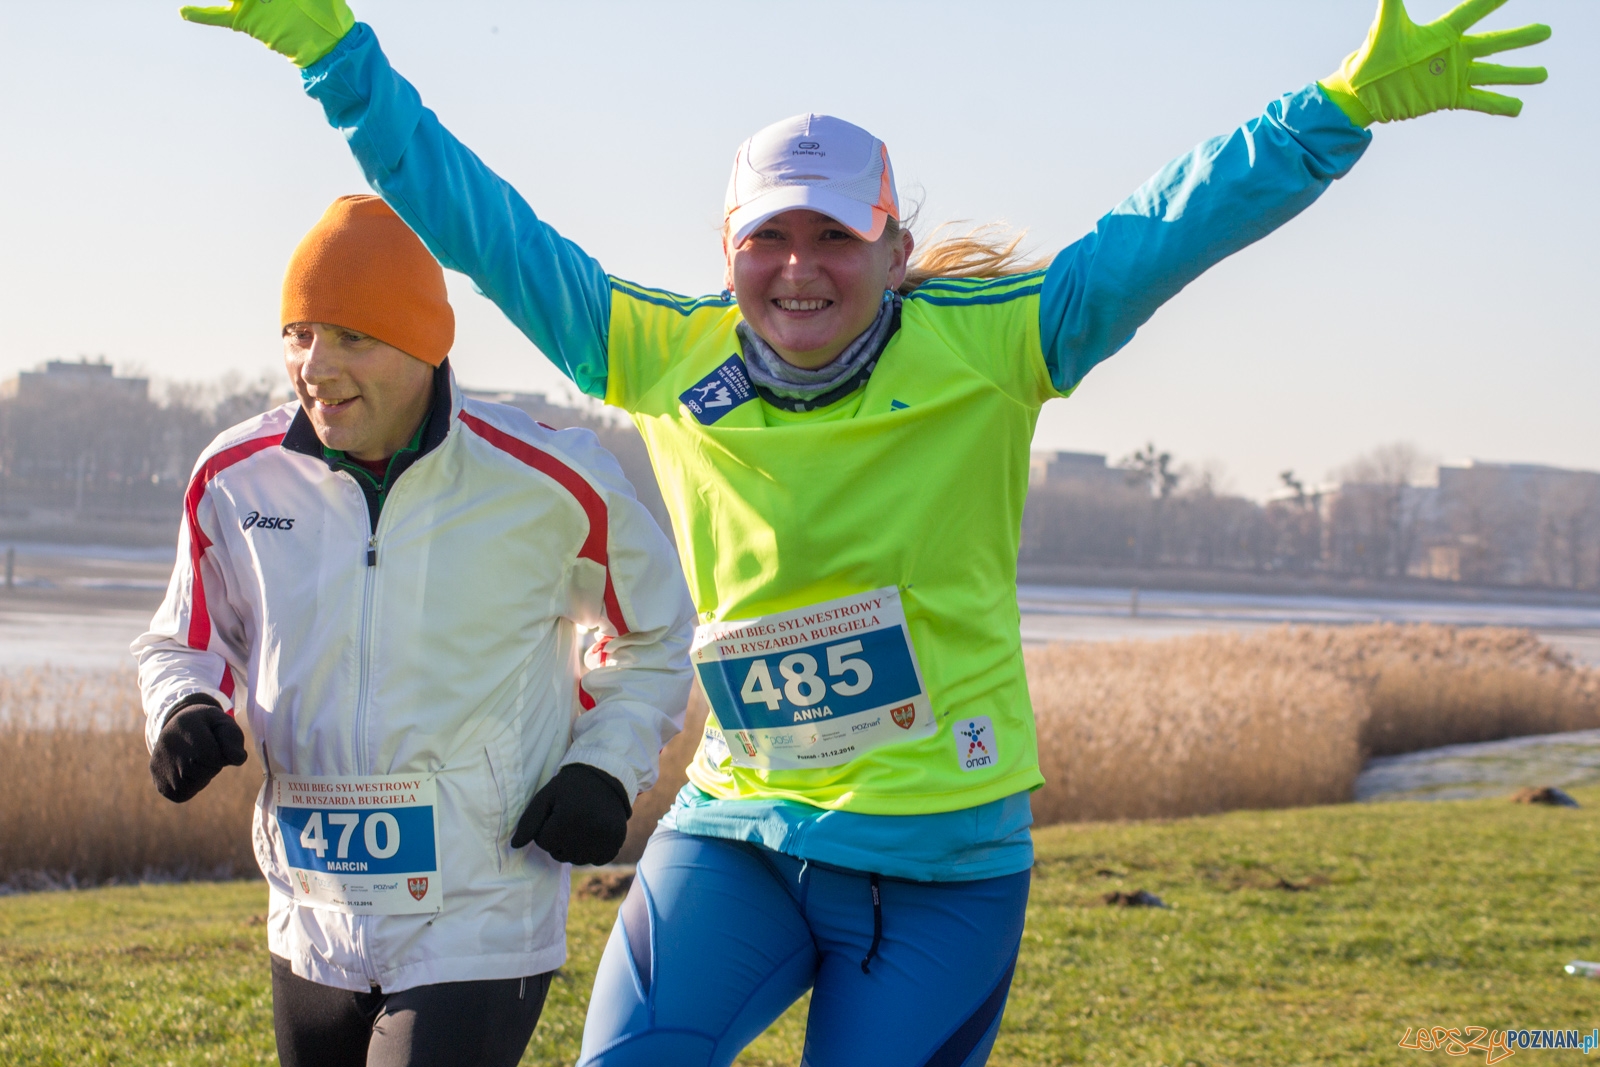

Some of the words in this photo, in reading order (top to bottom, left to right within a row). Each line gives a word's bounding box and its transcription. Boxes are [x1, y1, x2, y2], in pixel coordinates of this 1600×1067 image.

[717, 369, 725, 378] THE
[724, 377, 744, 400] AUTHENTIC
[721, 365, 750, 398] MARATHON
[731, 365, 751, 390] ATHENS
[256, 516, 296, 530] asics
[745, 623, 777, 638] BIEG
[779, 597, 883, 633] SYLWESTROWY
[720, 644, 740, 656] IM.
[741, 635, 809, 653] RYSZARDA
[810, 615, 881, 640] BURGIELA
[740, 639, 873, 711] 485
[793, 705, 833, 722] ANNA
[820, 745, 856, 758] 31.12.2016
[287, 781, 310, 792] XXXII
[311, 782, 334, 793] BIEG
[335, 780, 421, 793] SYLWESTROWY
[292, 795, 305, 804] IM.
[306, 795, 356, 805] RYSZARDA
[358, 793, 417, 805] BURGIELA
[299, 811, 401, 860] 470
[326, 861, 368, 871] MARCIN
